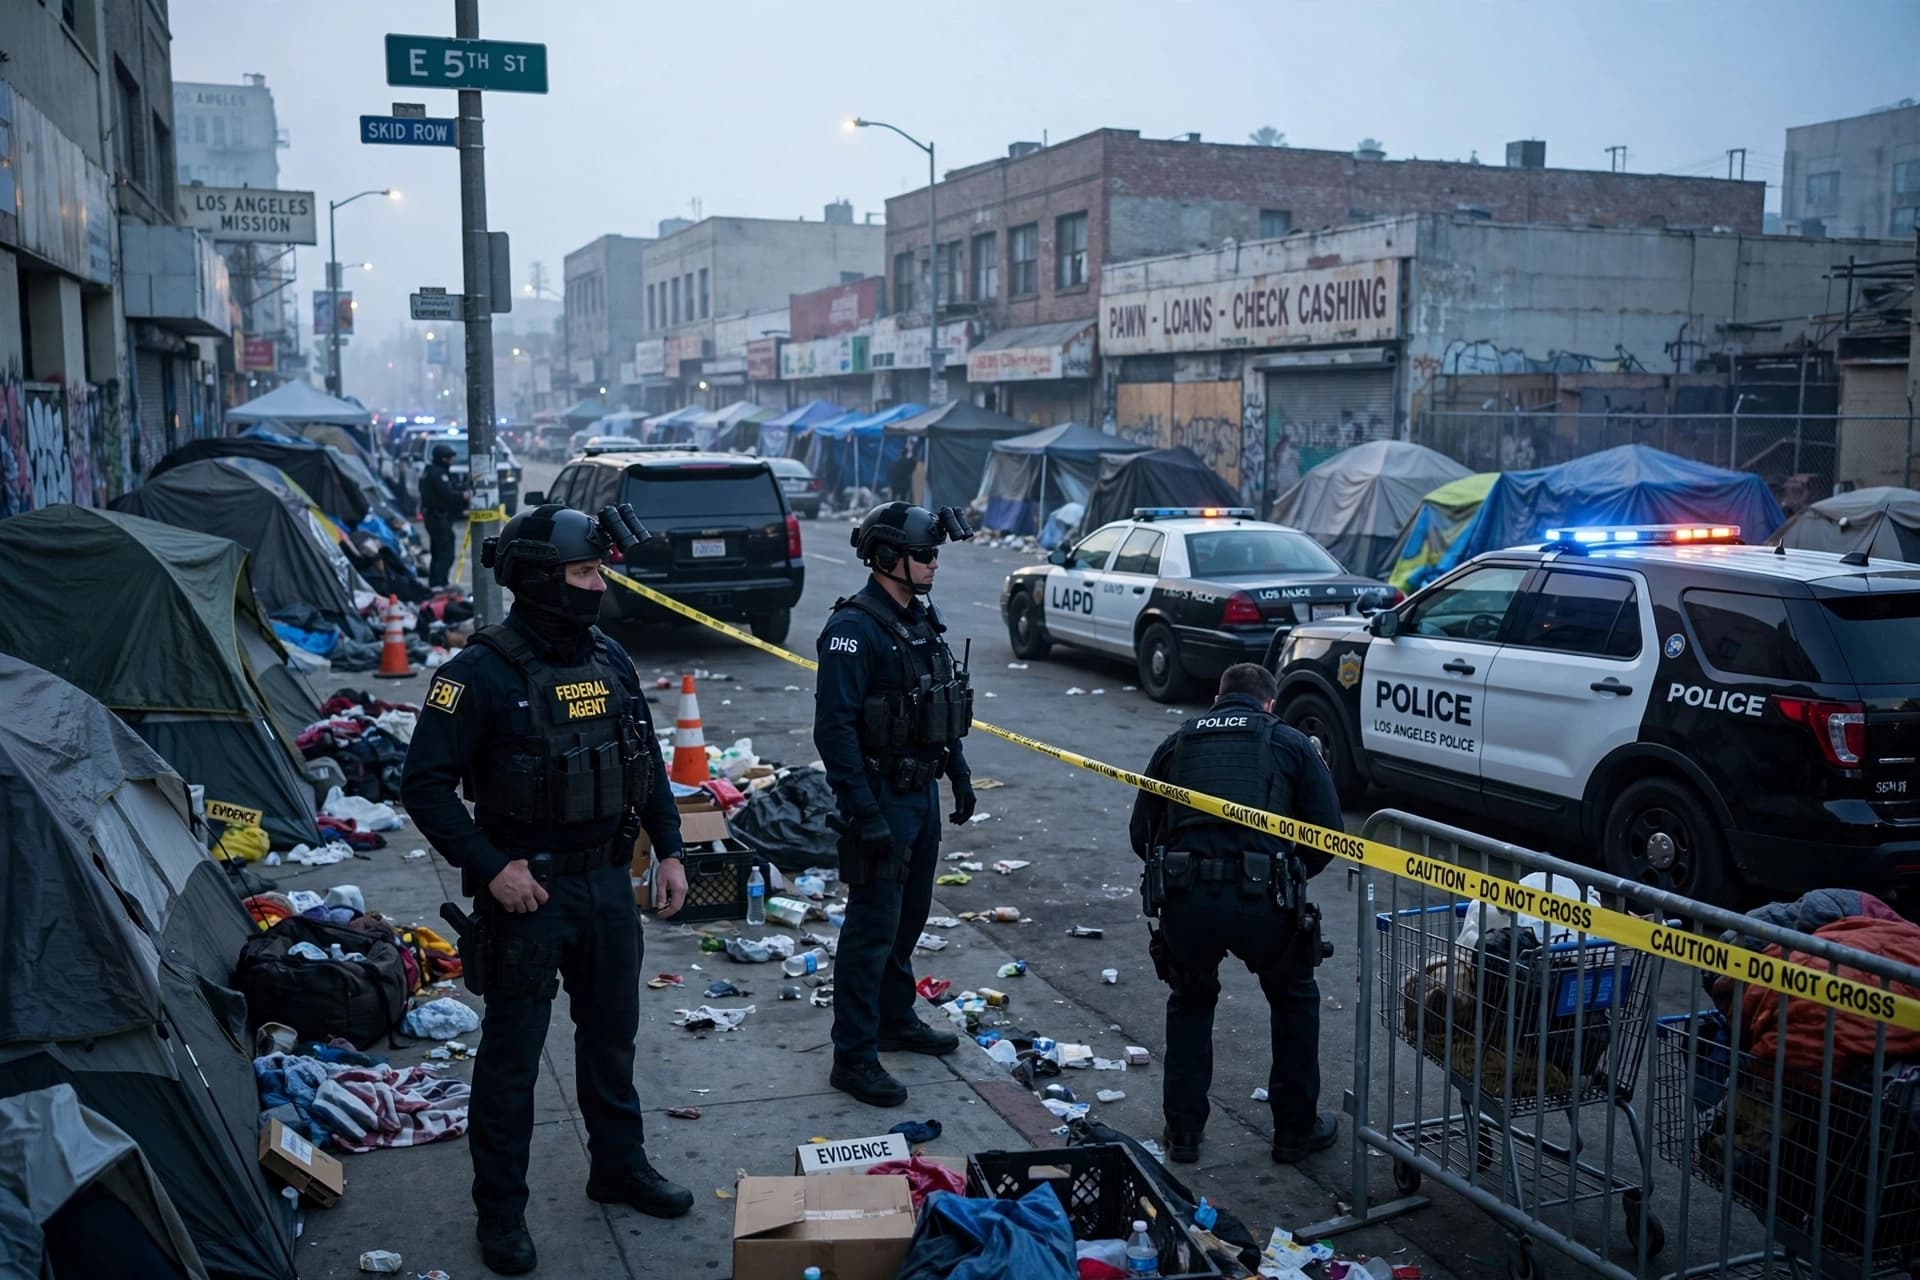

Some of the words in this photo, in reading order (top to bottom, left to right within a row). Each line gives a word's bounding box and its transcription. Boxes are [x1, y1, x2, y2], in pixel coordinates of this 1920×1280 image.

[409, 48, 429, 77] E
[443, 49, 489, 78] 5TH
[503, 54, 527, 73] ST
[368, 122, 406, 140] SKID
[413, 123, 447, 142] ROW
[196, 194, 227, 212] LOS
[233, 196, 308, 216] ANGELES
[221, 215, 290, 233] MISSION
[1109, 304, 1147, 339] PAWN
[1163, 296, 1212, 335] LOANS
[1232, 287, 1290, 329] CHECK
[1298, 276, 1387, 325] CASHING
[1052, 586, 1093, 615] LAPD
[829, 637, 858, 653] DHS
[430, 679, 458, 708] FBI
[555, 680, 610, 702] FEDERAL
[1376, 680, 1473, 727] POLICE
[1666, 683, 1767, 717] POLICE
[568, 698, 607, 719] AGENT
[1196, 716, 1248, 729] POLICE
[1374, 719, 1392, 734] LOS
[1393, 725, 1437, 745] ANGELES
[1439, 733, 1475, 753] POLICE
[1222, 803, 1269, 829] CAUTION
[1299, 825, 1321, 847] NOT
[1323, 834, 1364, 860] CROSS
[1406, 857, 1466, 892] CAUTION
[1479, 879, 1500, 901] DO
[1505, 886, 1535, 913] NOT
[1539, 897, 1592, 929] CROSS
[1651, 929, 1729, 970] CAUTION
[1748, 957, 1775, 983] DO
[1781, 965, 1821, 996] NOT
[1826, 980, 1896, 1019] CROSS
[816, 1141, 892, 1165] EVIDENCE
